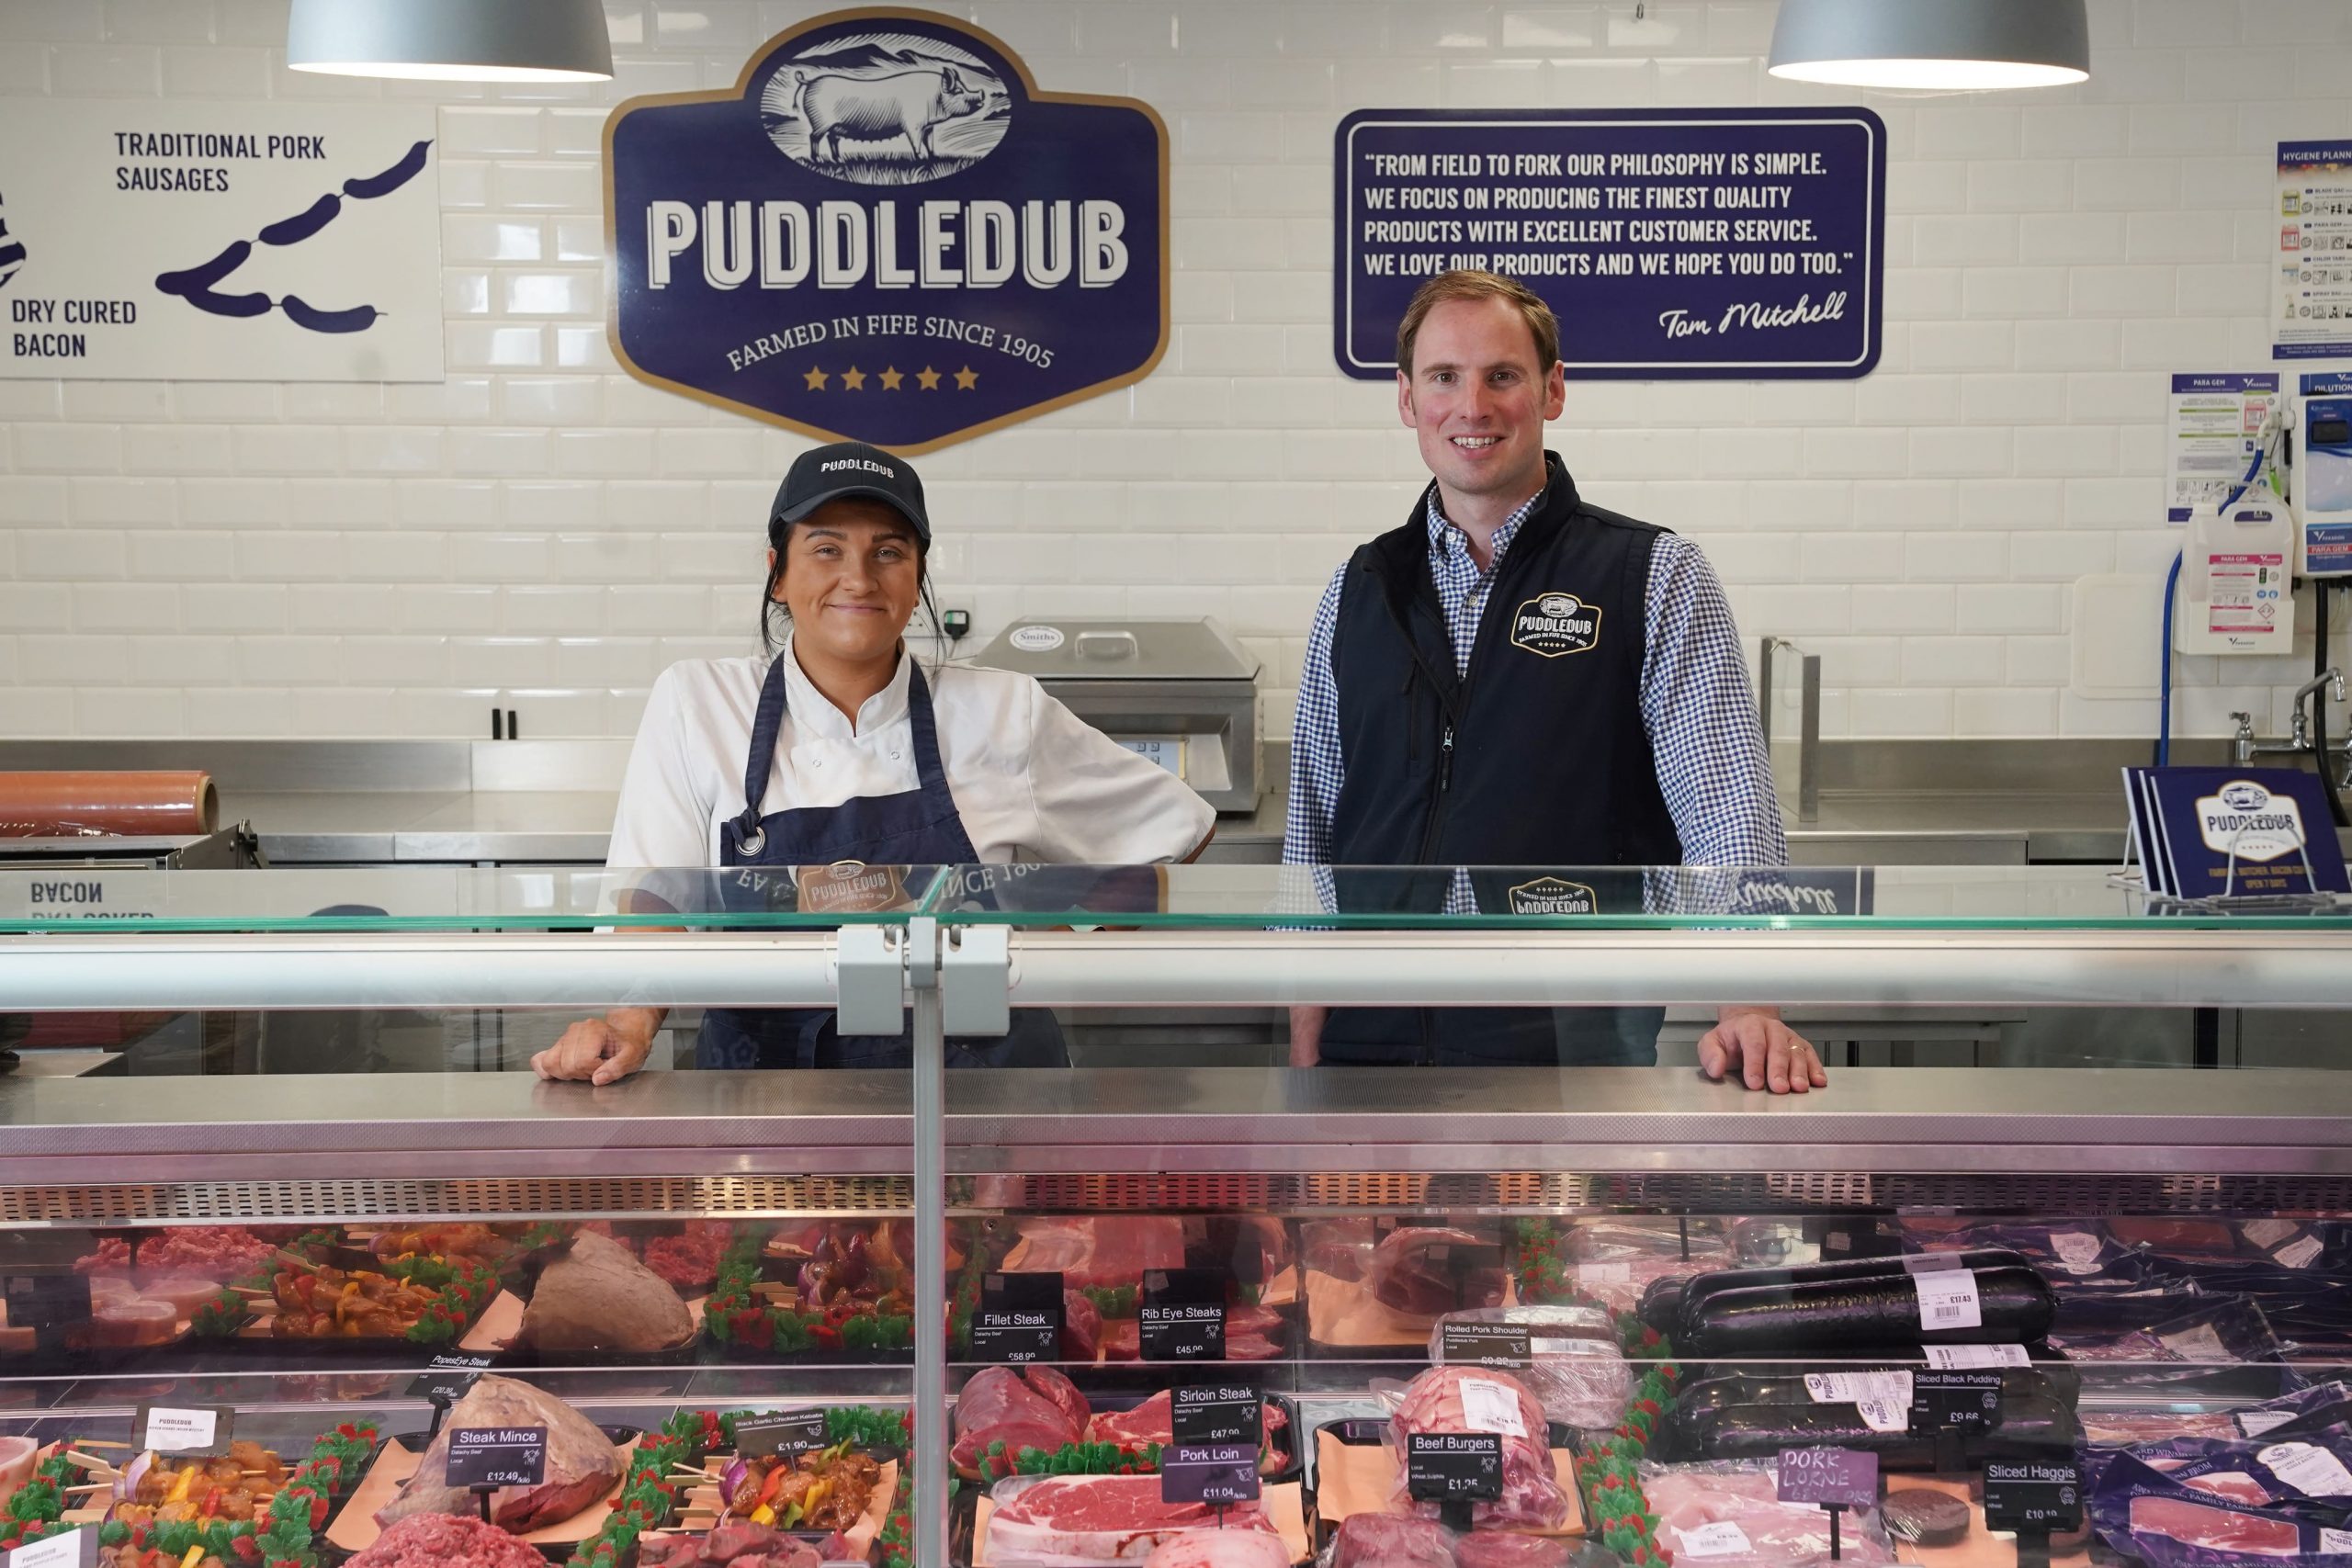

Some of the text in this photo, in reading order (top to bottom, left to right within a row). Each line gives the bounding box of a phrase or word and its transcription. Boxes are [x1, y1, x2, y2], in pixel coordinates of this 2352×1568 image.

[115, 132, 326, 160] TRADITIONAL PORK
[1431, 154, 1482, 176] FIELD
[1487, 154, 1510, 176] TO
[1515, 154, 1562, 176] FORK
[1567, 154, 1605, 175] OUR
[1611, 153, 1725, 175] PHILOSOPHY
[1731, 153, 1748, 175] IS
[1754, 152, 1826, 175] SIMPLE.
[2283, 152, 2321, 161] HYGIENE
[117, 167, 229, 191] SAUSAGES
[1364, 186, 1792, 209] WE FOCUS ON PRODUCING THE FINEST QUALITY
[1364, 220, 1817, 243] PRODUCTS WITH EXCELLENT CUSTOMER SERVICE.
[646, 200, 1129, 290] PUDDLEDUB
[1364, 254, 1395, 276] WE
[1400, 254, 1444, 276] LOVE
[1450, 254, 1487, 271] OUR
[1493, 254, 1590, 276] PRODUCTS
[1596, 254, 1634, 276] AND
[1639, 254, 1669, 275] WE
[1675, 254, 1723, 275] HOPE
[1728, 254, 1764, 275] YOU
[1770, 254, 1795, 275] DO
[12, 299, 137, 324] DRY CURED
[1718, 291, 1847, 333] Mitchell
[13, 333, 86, 357] BACON
[726, 315, 1055, 372] FARMED IN FIFE SINCE 1905
[821, 459, 894, 479] PUDDLEDUB
[1519, 616, 1592, 635] PUDDLEDUB
[2207, 814, 2295, 831] PUDDLEDUB
[811, 872, 887, 902] PUDDLEDUB
[1950, 1295, 1971, 1303] £17.43
[984, 1314, 1046, 1325] Fillet Steak
[1142, 1306, 1221, 1320] Rib Eye Steaks
[1445, 1325, 1470, 1333] Rolled
[1493, 1326, 1528, 1335] Shoulder
[432, 1355, 492, 1366] PopesEye Steak
[1916, 1375, 2001, 1385] Sliced Black Pudding
[1180, 1387, 1252, 1402] Sirloin Steak
[459, 1430, 537, 1443] Steak Mince
[1416, 1437, 1495, 1451] Beef Burgers
[1180, 1448, 1239, 1461] Pork Loin
[1783, 1470, 1849, 1487] LORNE
[1989, 1464, 2075, 1482] Sliced Haggis
